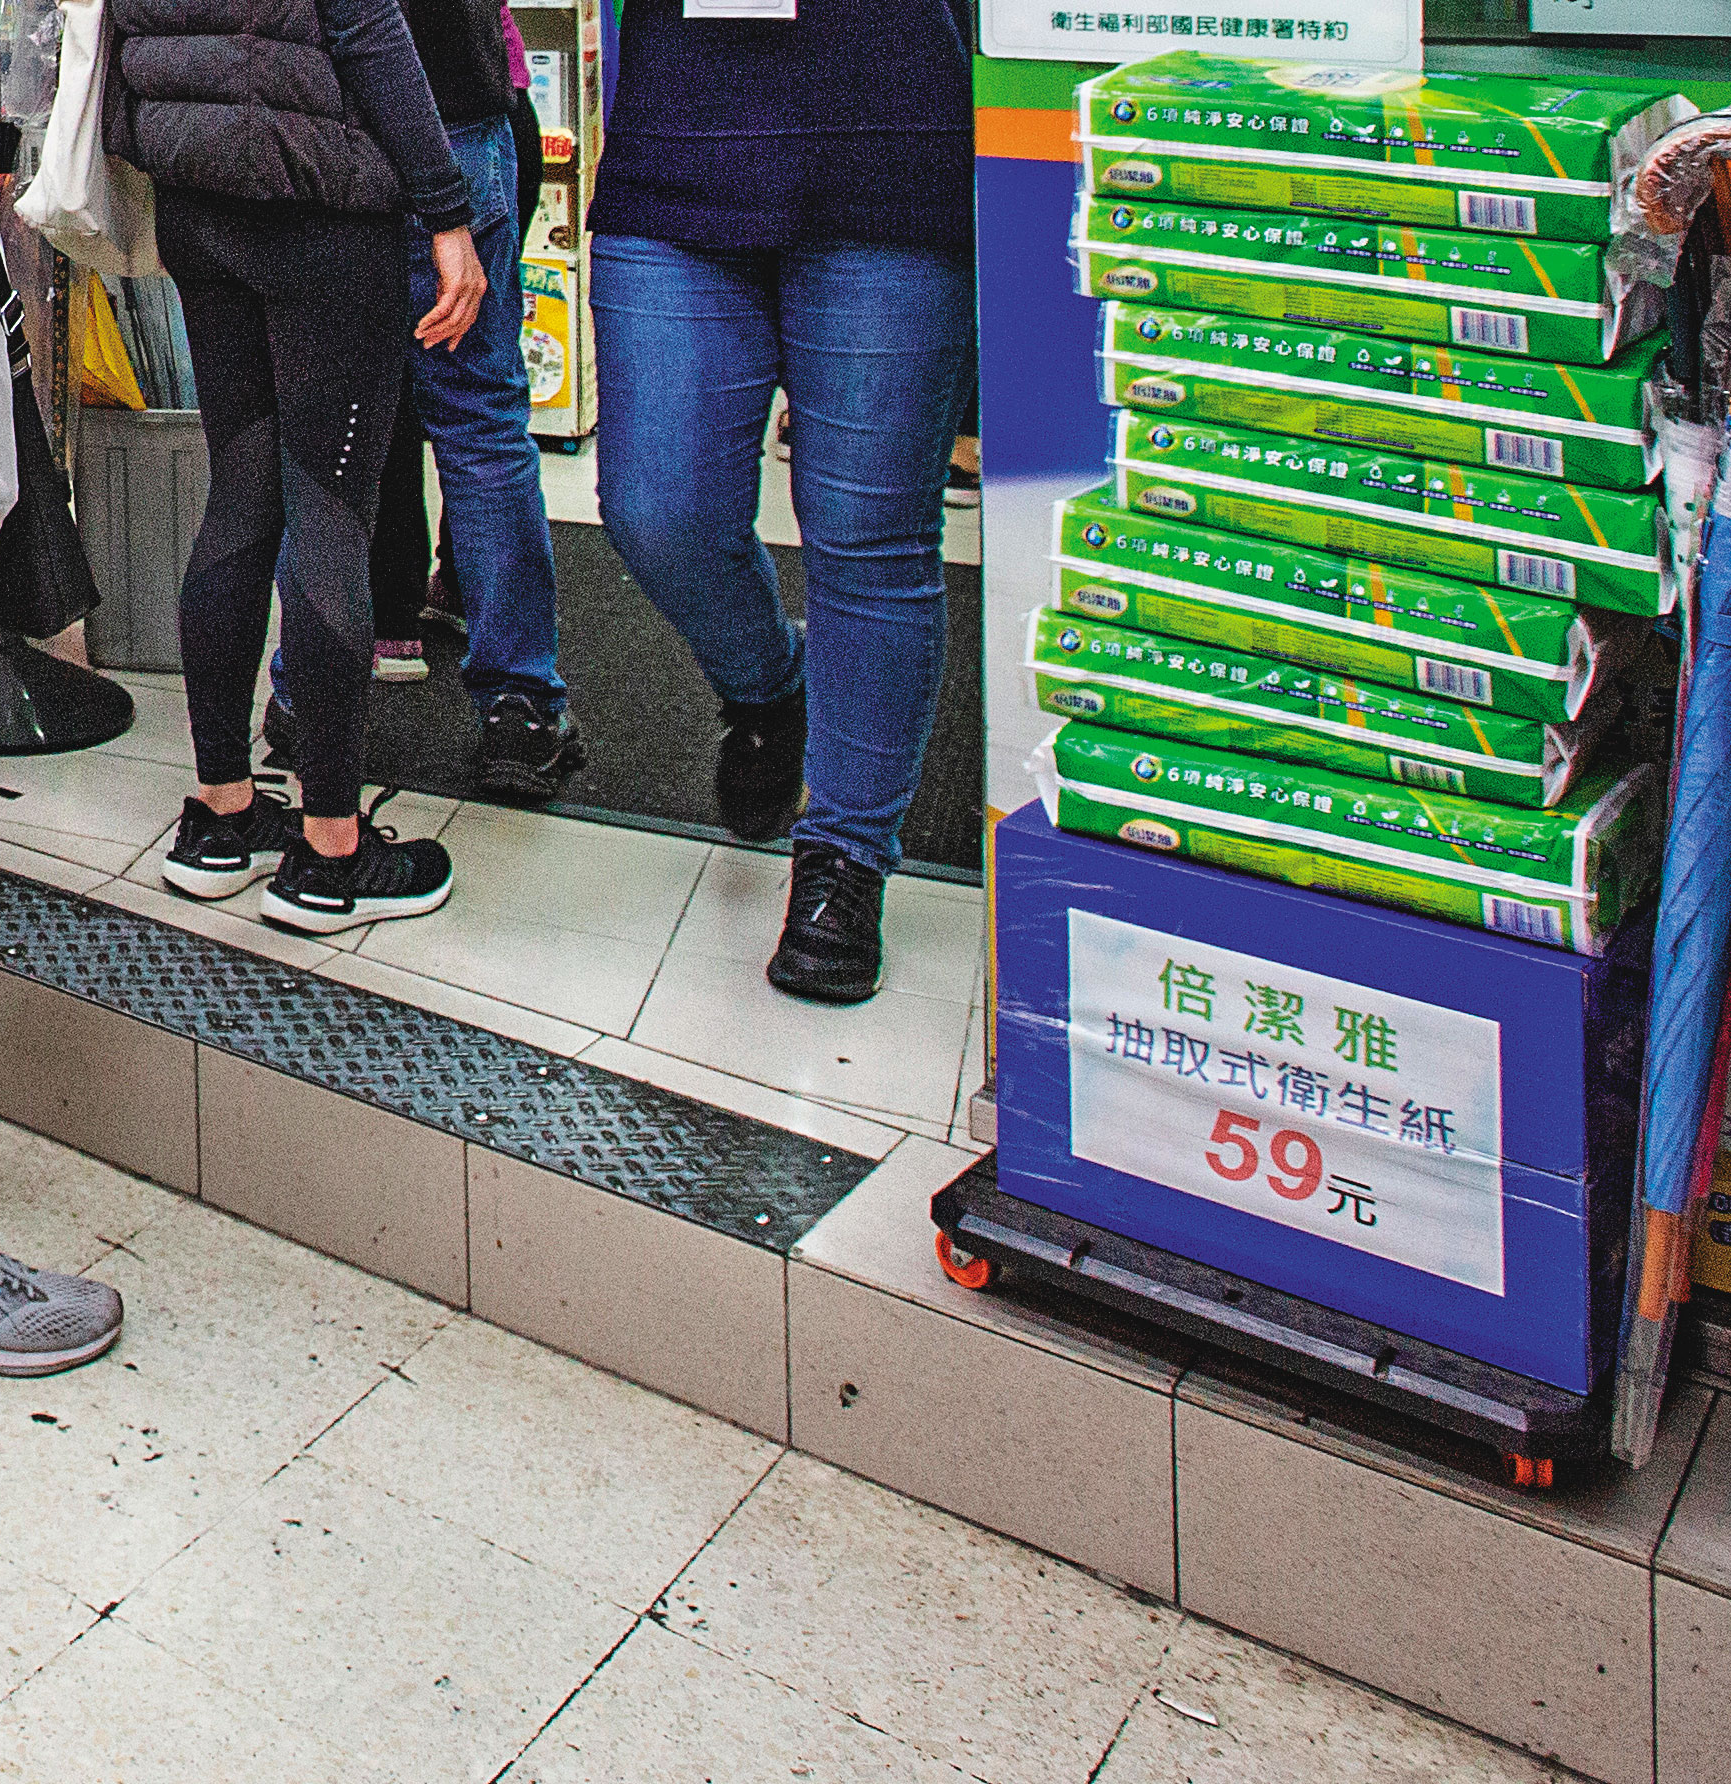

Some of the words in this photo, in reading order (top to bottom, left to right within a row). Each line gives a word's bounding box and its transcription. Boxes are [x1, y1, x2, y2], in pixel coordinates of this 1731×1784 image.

[1050, 12, 1349, 43] 衛生福利部國民健康署特約
[1146, 107, 1310, 136] 6項純淨安心保證
[1167, 763, 1332, 814] 6項純淨安心保證
[1158, 958, 1398, 1073] 倍潔雅
[1106, 1013, 1457, 1155] 抽取式衛生紙
